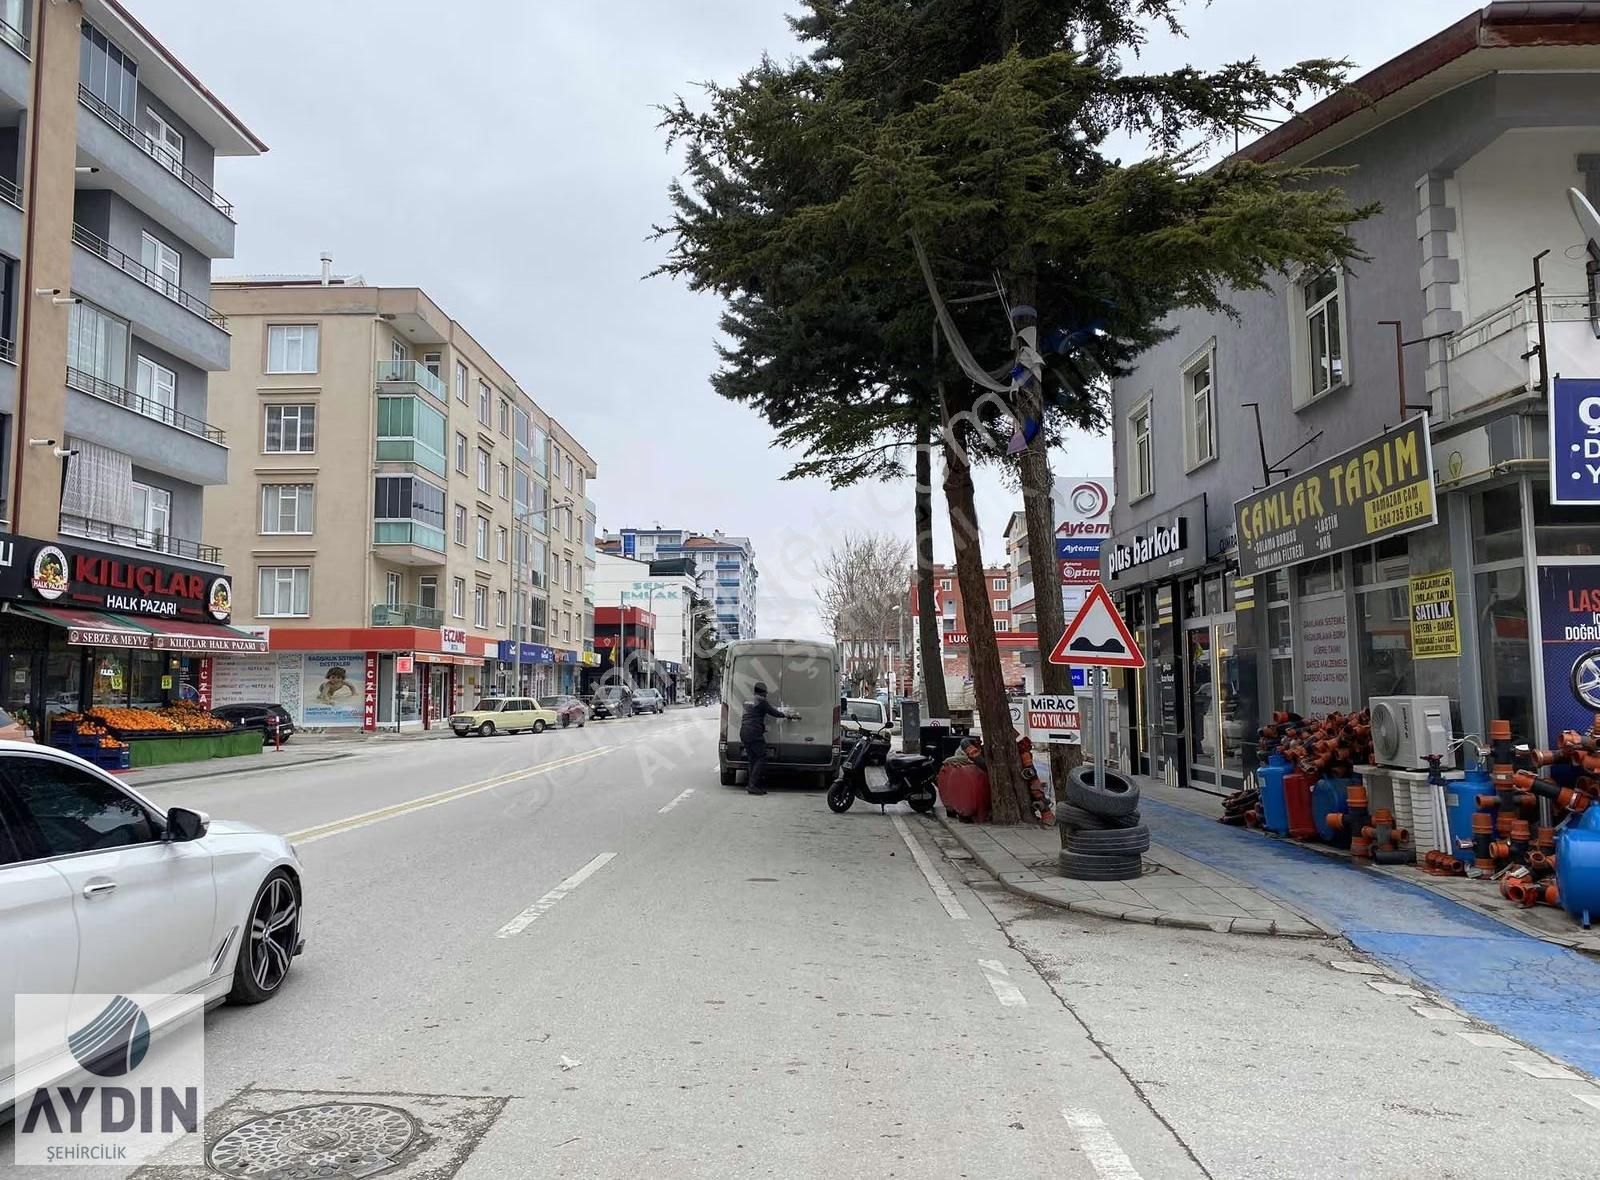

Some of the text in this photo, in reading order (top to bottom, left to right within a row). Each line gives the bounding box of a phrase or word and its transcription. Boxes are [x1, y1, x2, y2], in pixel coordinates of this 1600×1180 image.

[1241, 431, 1419, 549] ÇAMLAR TARIM
[1055, 521, 1111, 537] Aytem
[1108, 544, 1131, 581] plus
[1133, 517, 1180, 565] barkod
[75, 554, 205, 599] KILIÇLAR
[1064, 567, 1101, 579] Optim
[106, 594, 177, 615] HALK PAZARI
[1415, 601, 1451, 621] SATILIK
[82, 633, 149, 646] SEBZE & MEYVE
[170, 638, 256, 651] KILIÇLAR HALK PAZARI
[443, 629, 466, 644] ECZANE
[365, 658, 374, 726] ECZANE
[1031, 713, 1078, 728] OTO YIKAMA
